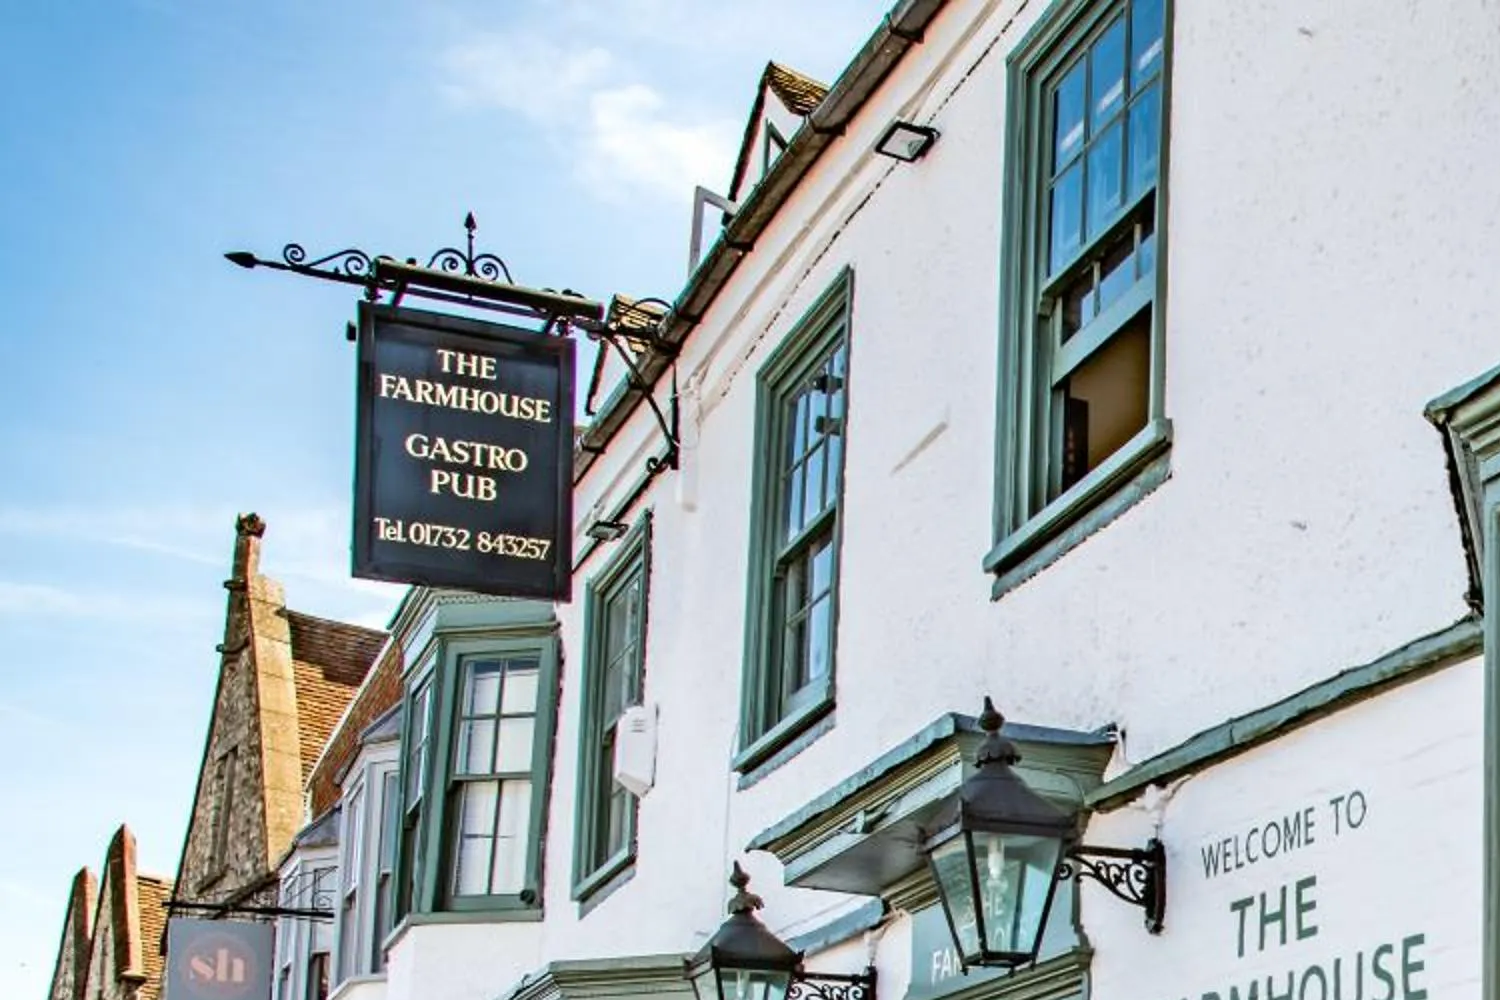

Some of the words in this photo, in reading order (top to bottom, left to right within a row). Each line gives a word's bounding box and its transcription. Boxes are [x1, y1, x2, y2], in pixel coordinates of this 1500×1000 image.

[437, 349, 497, 380] THE
[379, 374, 551, 423] FARMHOUSE
[404, 433, 529, 472] GASTRO
[430, 469, 498, 501] PUB
[409, 522, 470, 550] 01732
[476, 531, 551, 560] 843257
[1201, 807, 1316, 879] WELCOME
[1329, 790, 1367, 836] TO
[1230, 876, 1319, 958] THE
